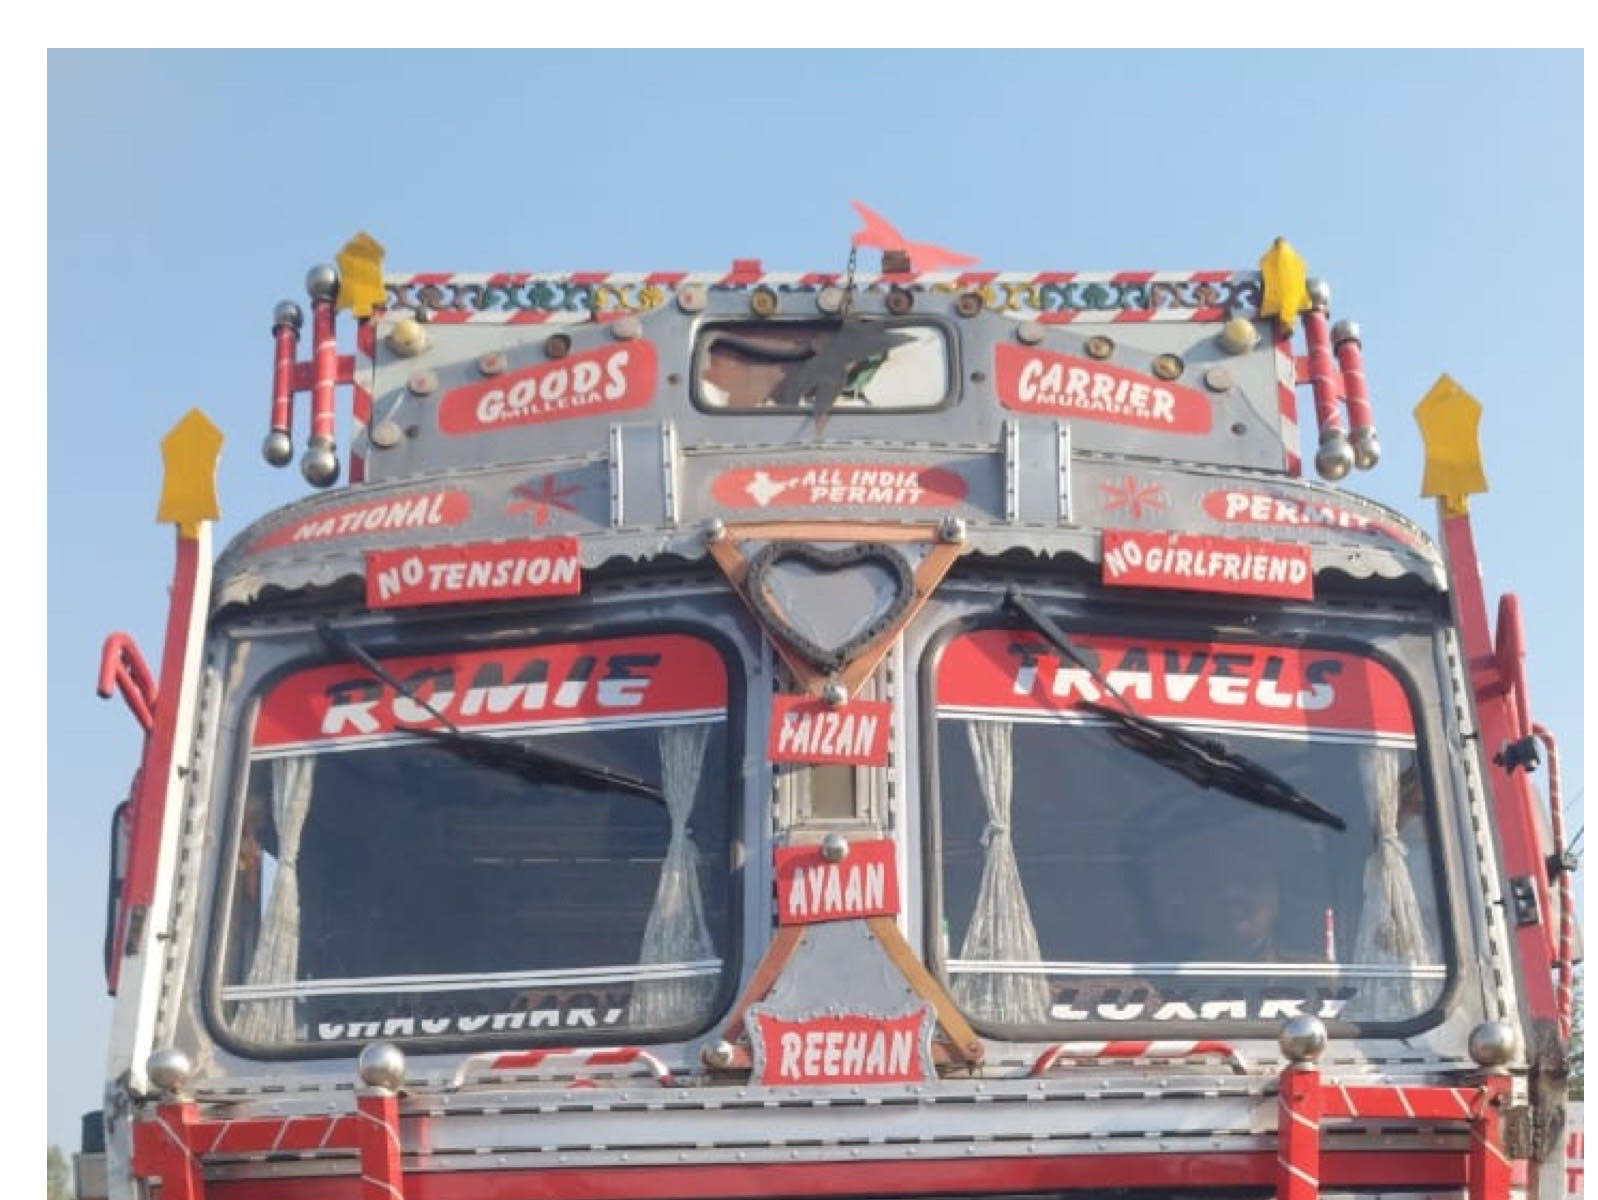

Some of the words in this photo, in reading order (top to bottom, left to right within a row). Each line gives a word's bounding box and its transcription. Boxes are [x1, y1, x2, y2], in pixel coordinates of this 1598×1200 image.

[476, 351, 628, 423] GOODS
[1018, 358, 1176, 423] CARRIER
[802, 469, 842, 488] ALL
[851, 470, 919, 488] INDIA
[810, 485, 922, 504] PERMIT
[291, 493, 445, 541] NATIONAL
[428, 556, 577, 591] TENSION
[1104, 540, 1143, 578] NO
[1145, 546, 1308, 585] GIRLFRIEND
[322, 652, 661, 734] ROMIE
[1008, 642, 1344, 711] TRAVELS
[778, 711, 879, 757] FAIZAN
[788, 862, 888, 916] AYAAN
[1049, 986, 1357, 1021] LUXARY
[779, 1032, 914, 1077] REEHAN
